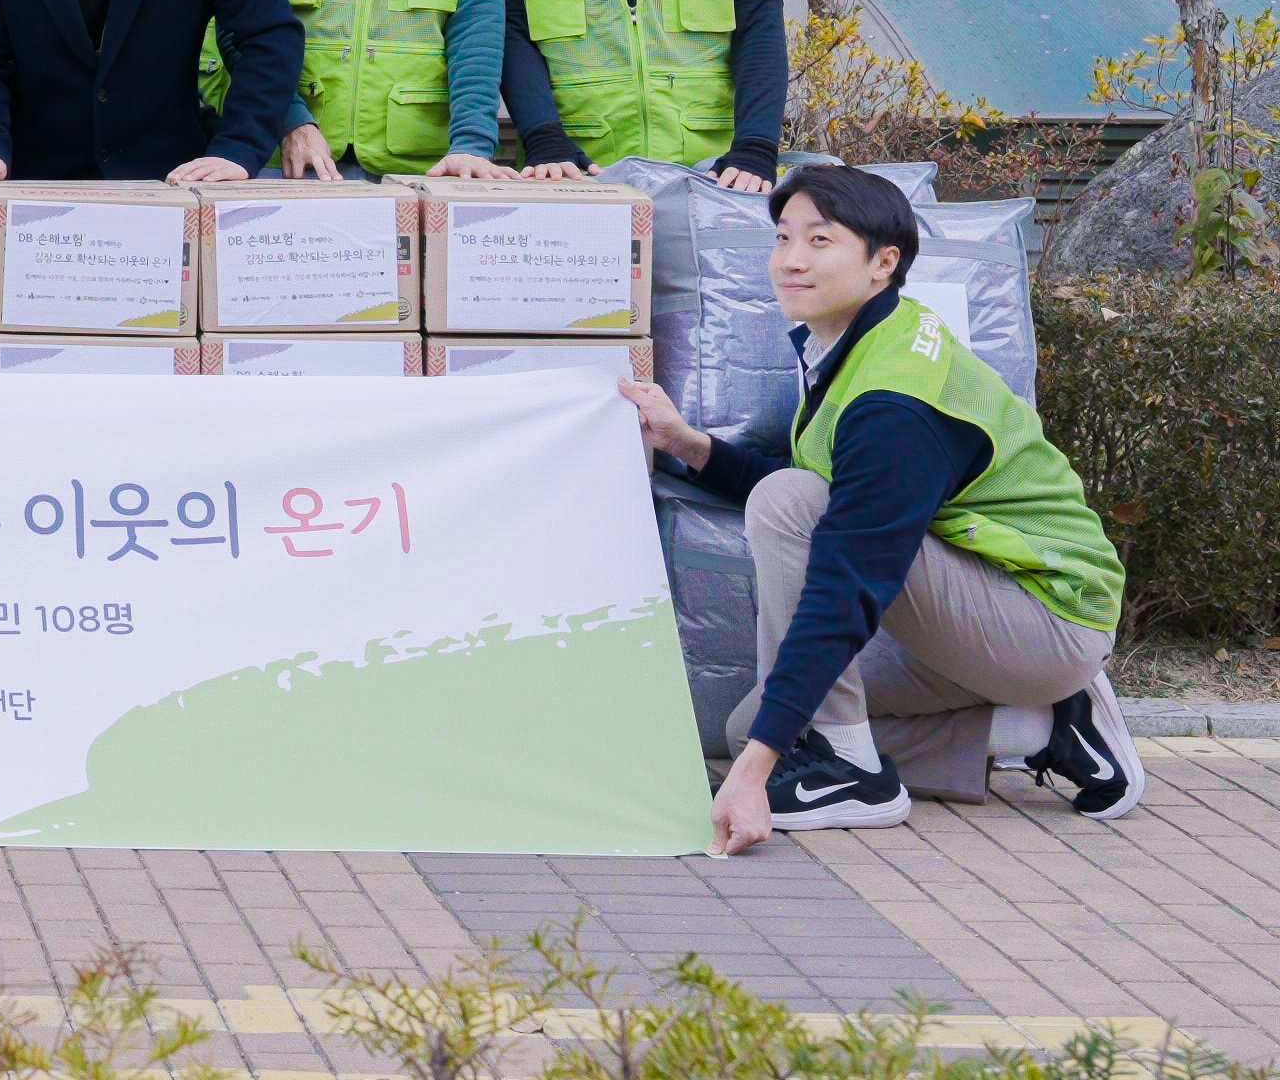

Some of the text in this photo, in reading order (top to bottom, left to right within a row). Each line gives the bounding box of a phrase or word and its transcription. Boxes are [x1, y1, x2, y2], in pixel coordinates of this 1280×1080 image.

[35, 252, 171, 267] 김장으로 확산되는 이웃의 온기
[245, 249, 385, 264] 김장으로 확산되는 이웃의 온기
[479, 254, 620, 267] 김장으로 확산되는 이웃의 온기
[23, 478, 240, 562] 이웃의
[263, 482, 411, 558] 온기
[34, 602, 135, 636] 108명
